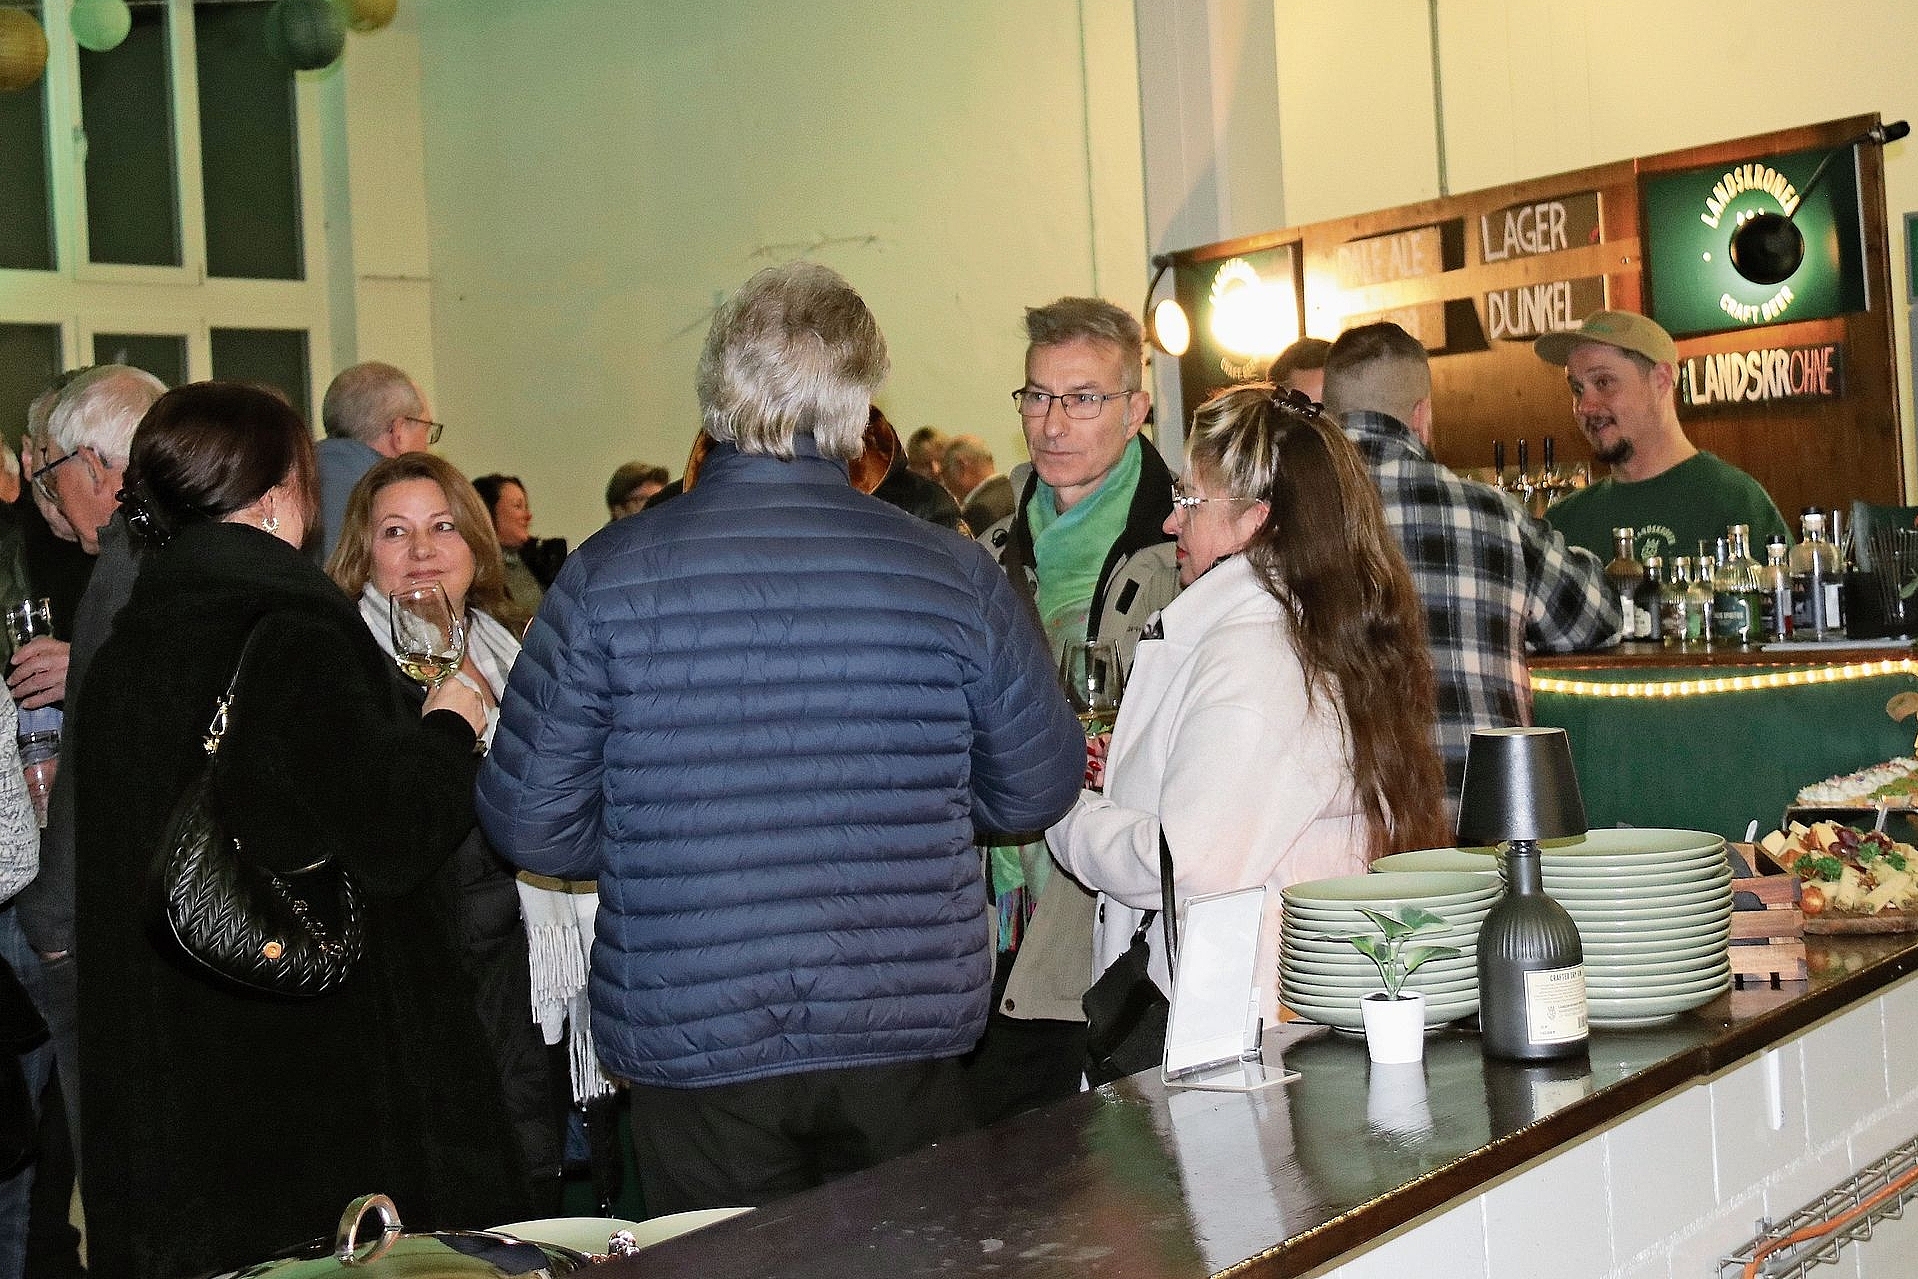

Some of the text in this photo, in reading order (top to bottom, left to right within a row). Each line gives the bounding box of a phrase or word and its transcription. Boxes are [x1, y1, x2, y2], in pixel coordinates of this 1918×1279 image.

[1481, 201, 1567, 262] LAGER
[1488, 280, 1583, 339] DUNKEL
[1687, 347, 1835, 405] LANDSKROHNE
